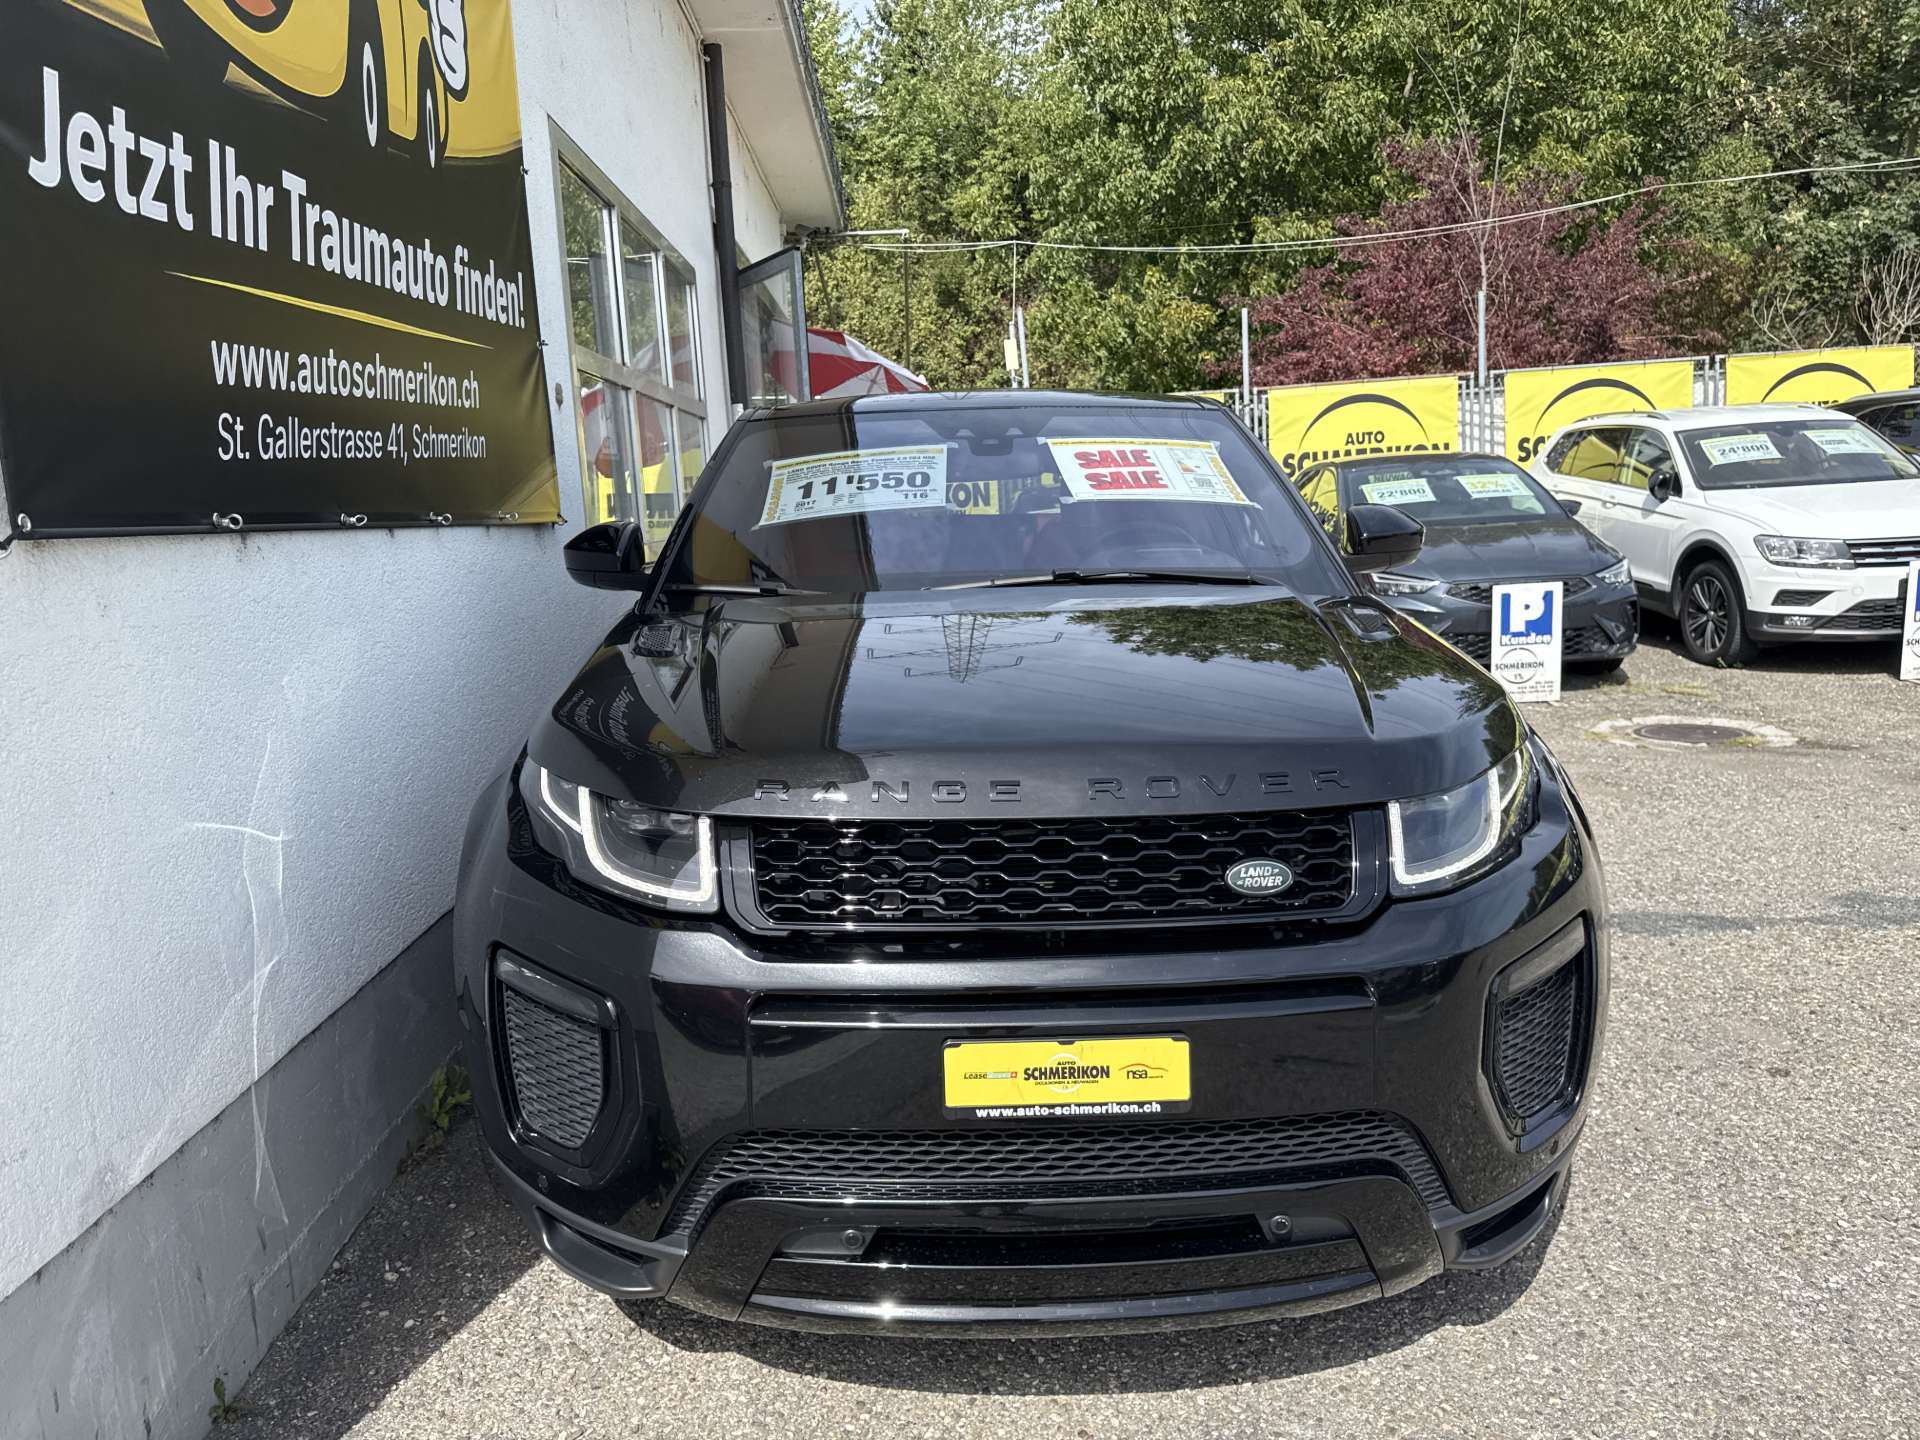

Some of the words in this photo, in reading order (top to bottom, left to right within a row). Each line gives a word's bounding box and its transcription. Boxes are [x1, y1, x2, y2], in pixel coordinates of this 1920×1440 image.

[28, 66, 193, 231] Jetzt
[208, 139, 274, 252] Ihr
[281, 170, 449, 307] Traumauto
[454, 246, 525, 328] finden!
[211, 340, 480, 409] www.autoschmerikon.ch
[218, 412, 250, 461] St.
[258, 413, 383, 461] Gallerstrasse
[387, 423, 408, 466] 41,
[412, 424, 486, 459] Schmerikon
[1345, 431, 1385, 446] AUTO
[1718, 444, 1769, 456] 24'800
[1074, 449, 1156, 469] SALE
[798, 471, 931, 499] 11'550
[1084, 471, 1169, 490] SALE
[1377, 487, 1426, 499] 22'800
[1510, 591, 1544, 632] P
[1501, 632, 1552, 645] Kunden
[1495, 661, 1544, 671] SCHMERIKON
[753, 778, 1021, 803] RANGE
[1087, 768, 1350, 801] ROVER
[1240, 866, 1272, 877] LAND
[1244, 875, 1283, 887] ROVER
[1023, 1065, 1110, 1081] SCHMERIKON
[1126, 1065, 1148, 1079] nsa
[975, 1102, 1161, 1118] www.auto-schmerikon.ch
